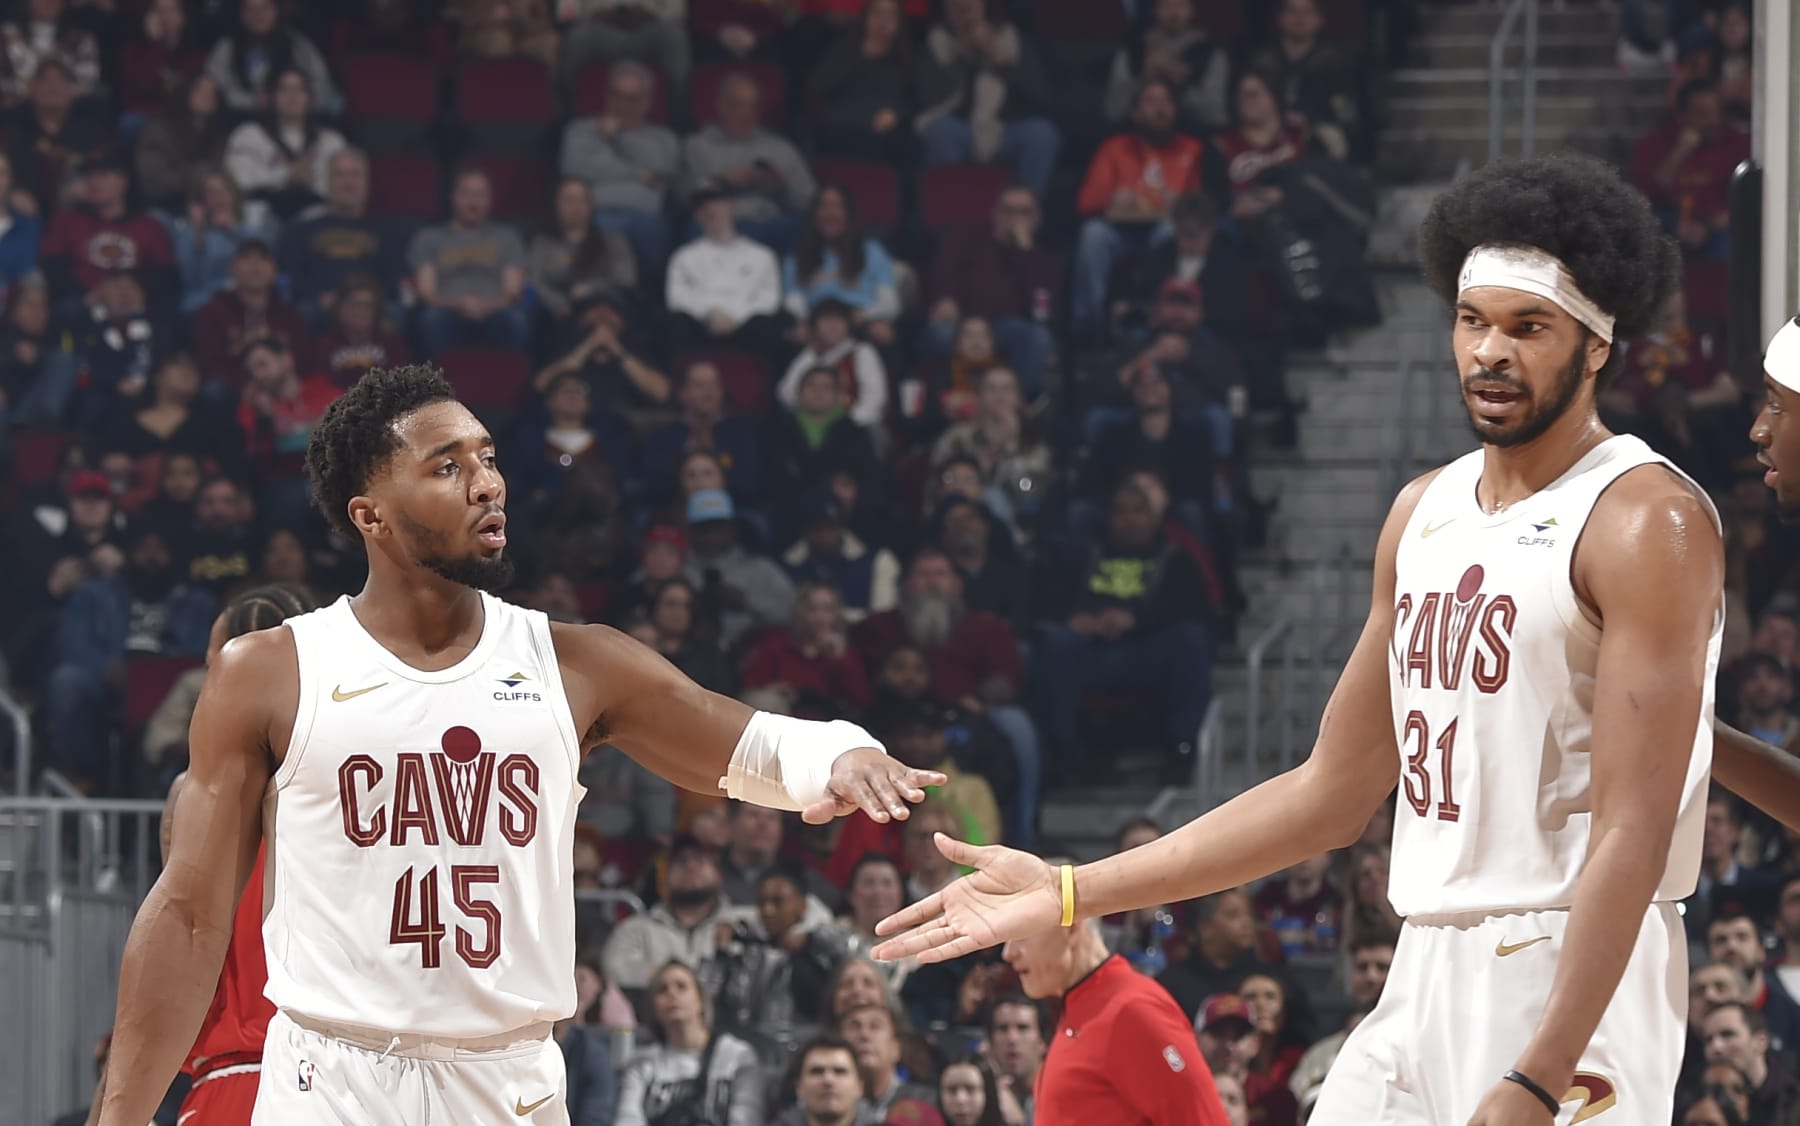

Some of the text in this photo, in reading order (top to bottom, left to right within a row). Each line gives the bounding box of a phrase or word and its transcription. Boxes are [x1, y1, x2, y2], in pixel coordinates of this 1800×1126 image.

[1517, 536, 1556, 548] CLIFFS
[1391, 592, 1518, 694] CAVS
[493, 691, 542, 702] CLIFFS
[338, 752, 540, 848] CAVS
[1403, 710, 1461, 823] 31
[389, 864, 502, 969] 45
